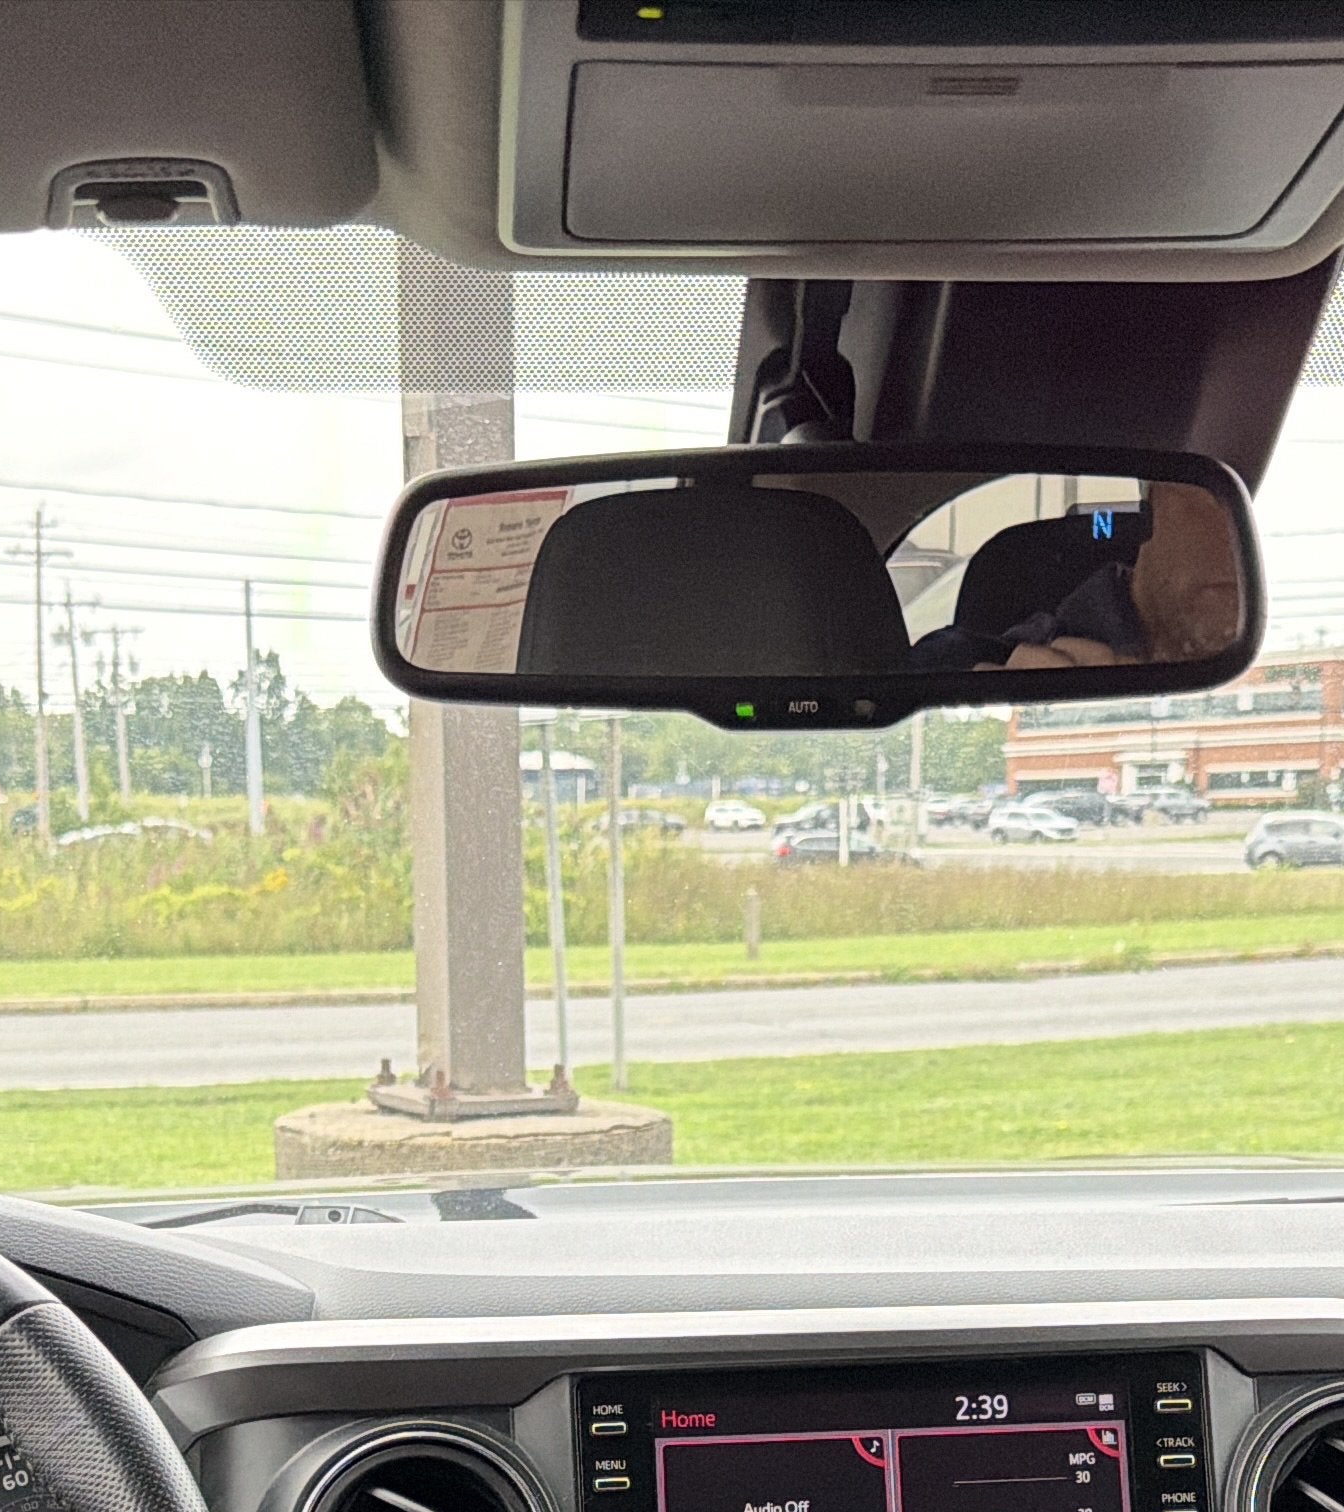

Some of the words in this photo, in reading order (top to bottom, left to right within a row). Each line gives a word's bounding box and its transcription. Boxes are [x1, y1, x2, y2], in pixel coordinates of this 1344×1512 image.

[1092, 509, 1113, 540] N
[787, 700, 819, 714] AUTO
[592, 1404, 624, 1416] HOME
[955, 1394, 1009, 1421] 2:39
[661, 1410, 716, 1428] Home
[595, 1459, 627, 1471] MENU
[1068, 1453, 1096, 1466] MPG
[2, 1469, 30, 1492] 60
[1075, 1470, 1091, 1484] 30
[1161, 1492, 1197, 1504] PHONE
